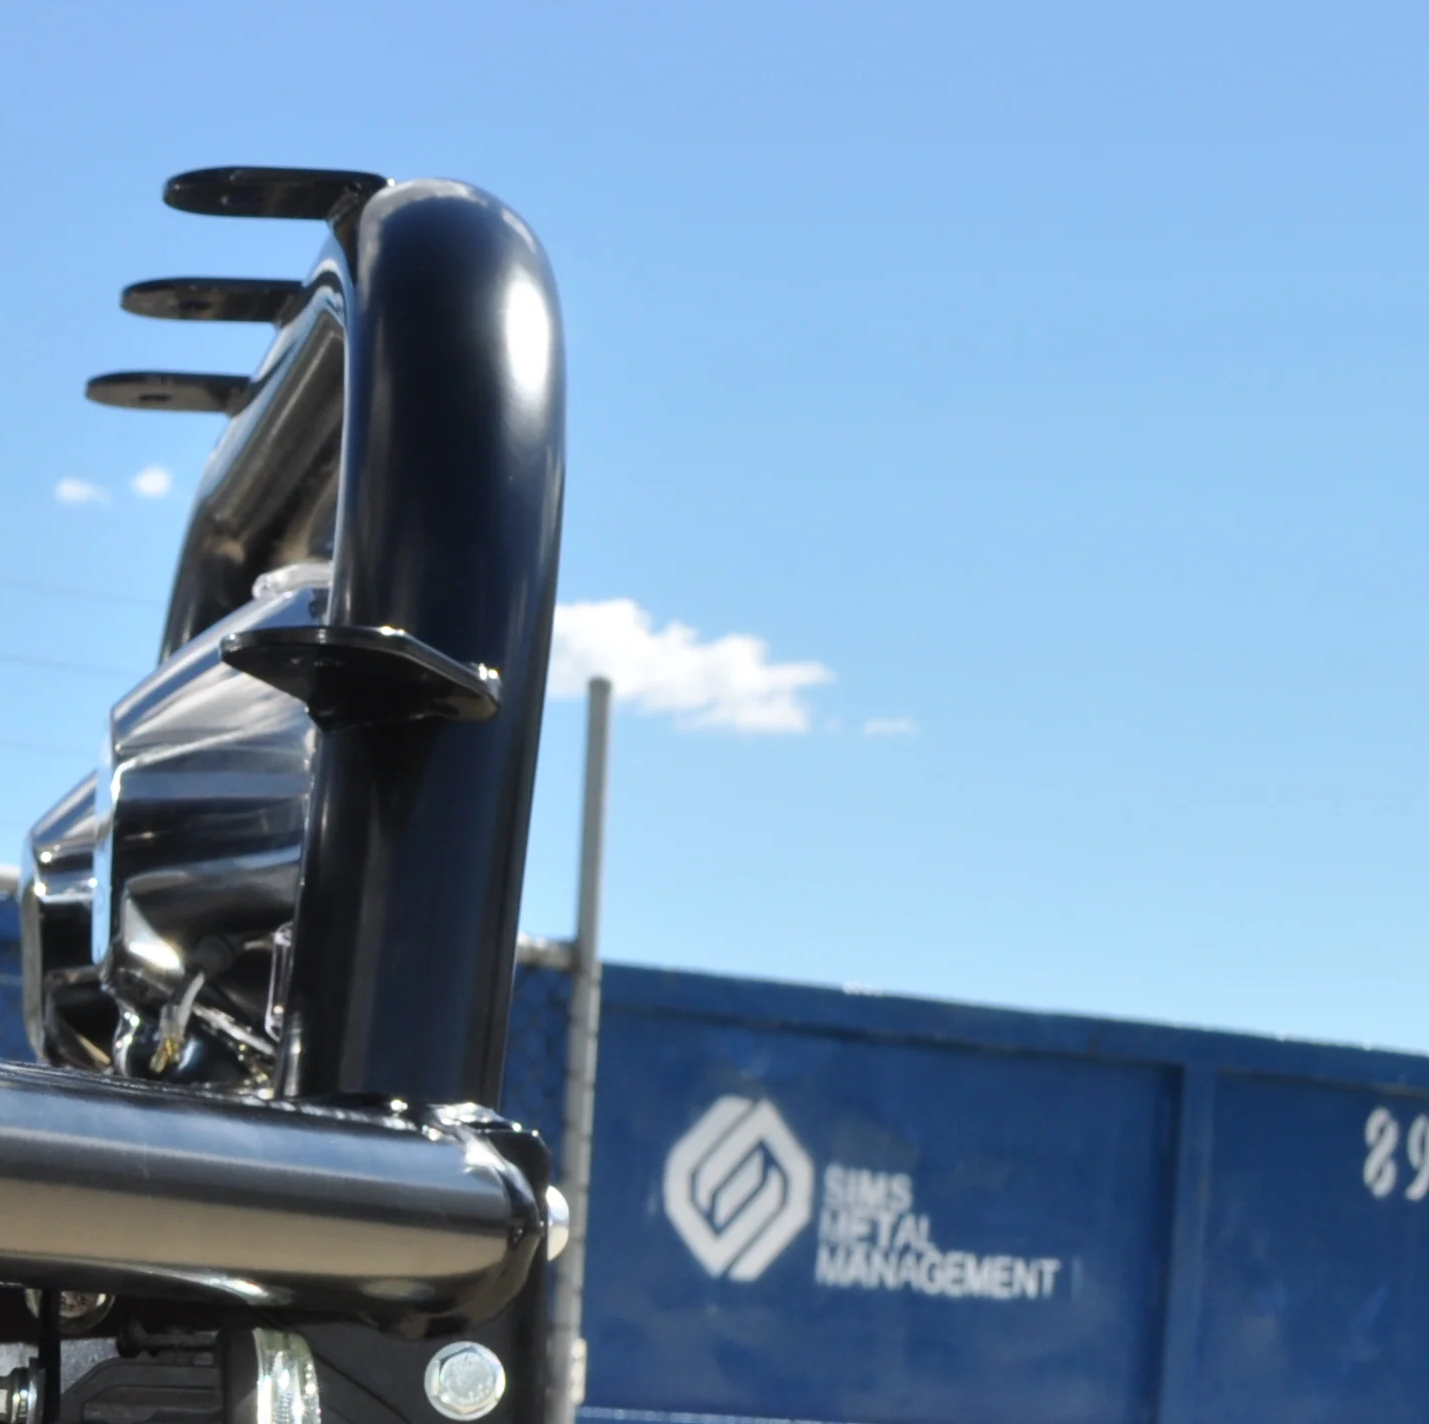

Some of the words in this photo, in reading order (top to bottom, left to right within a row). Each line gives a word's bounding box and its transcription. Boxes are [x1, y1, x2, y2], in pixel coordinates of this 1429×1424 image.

[824, 1163, 913, 1213] SIMS
[819, 1206, 933, 1251] METAL
[815, 1244, 1062, 1299] MANAGEMENT
